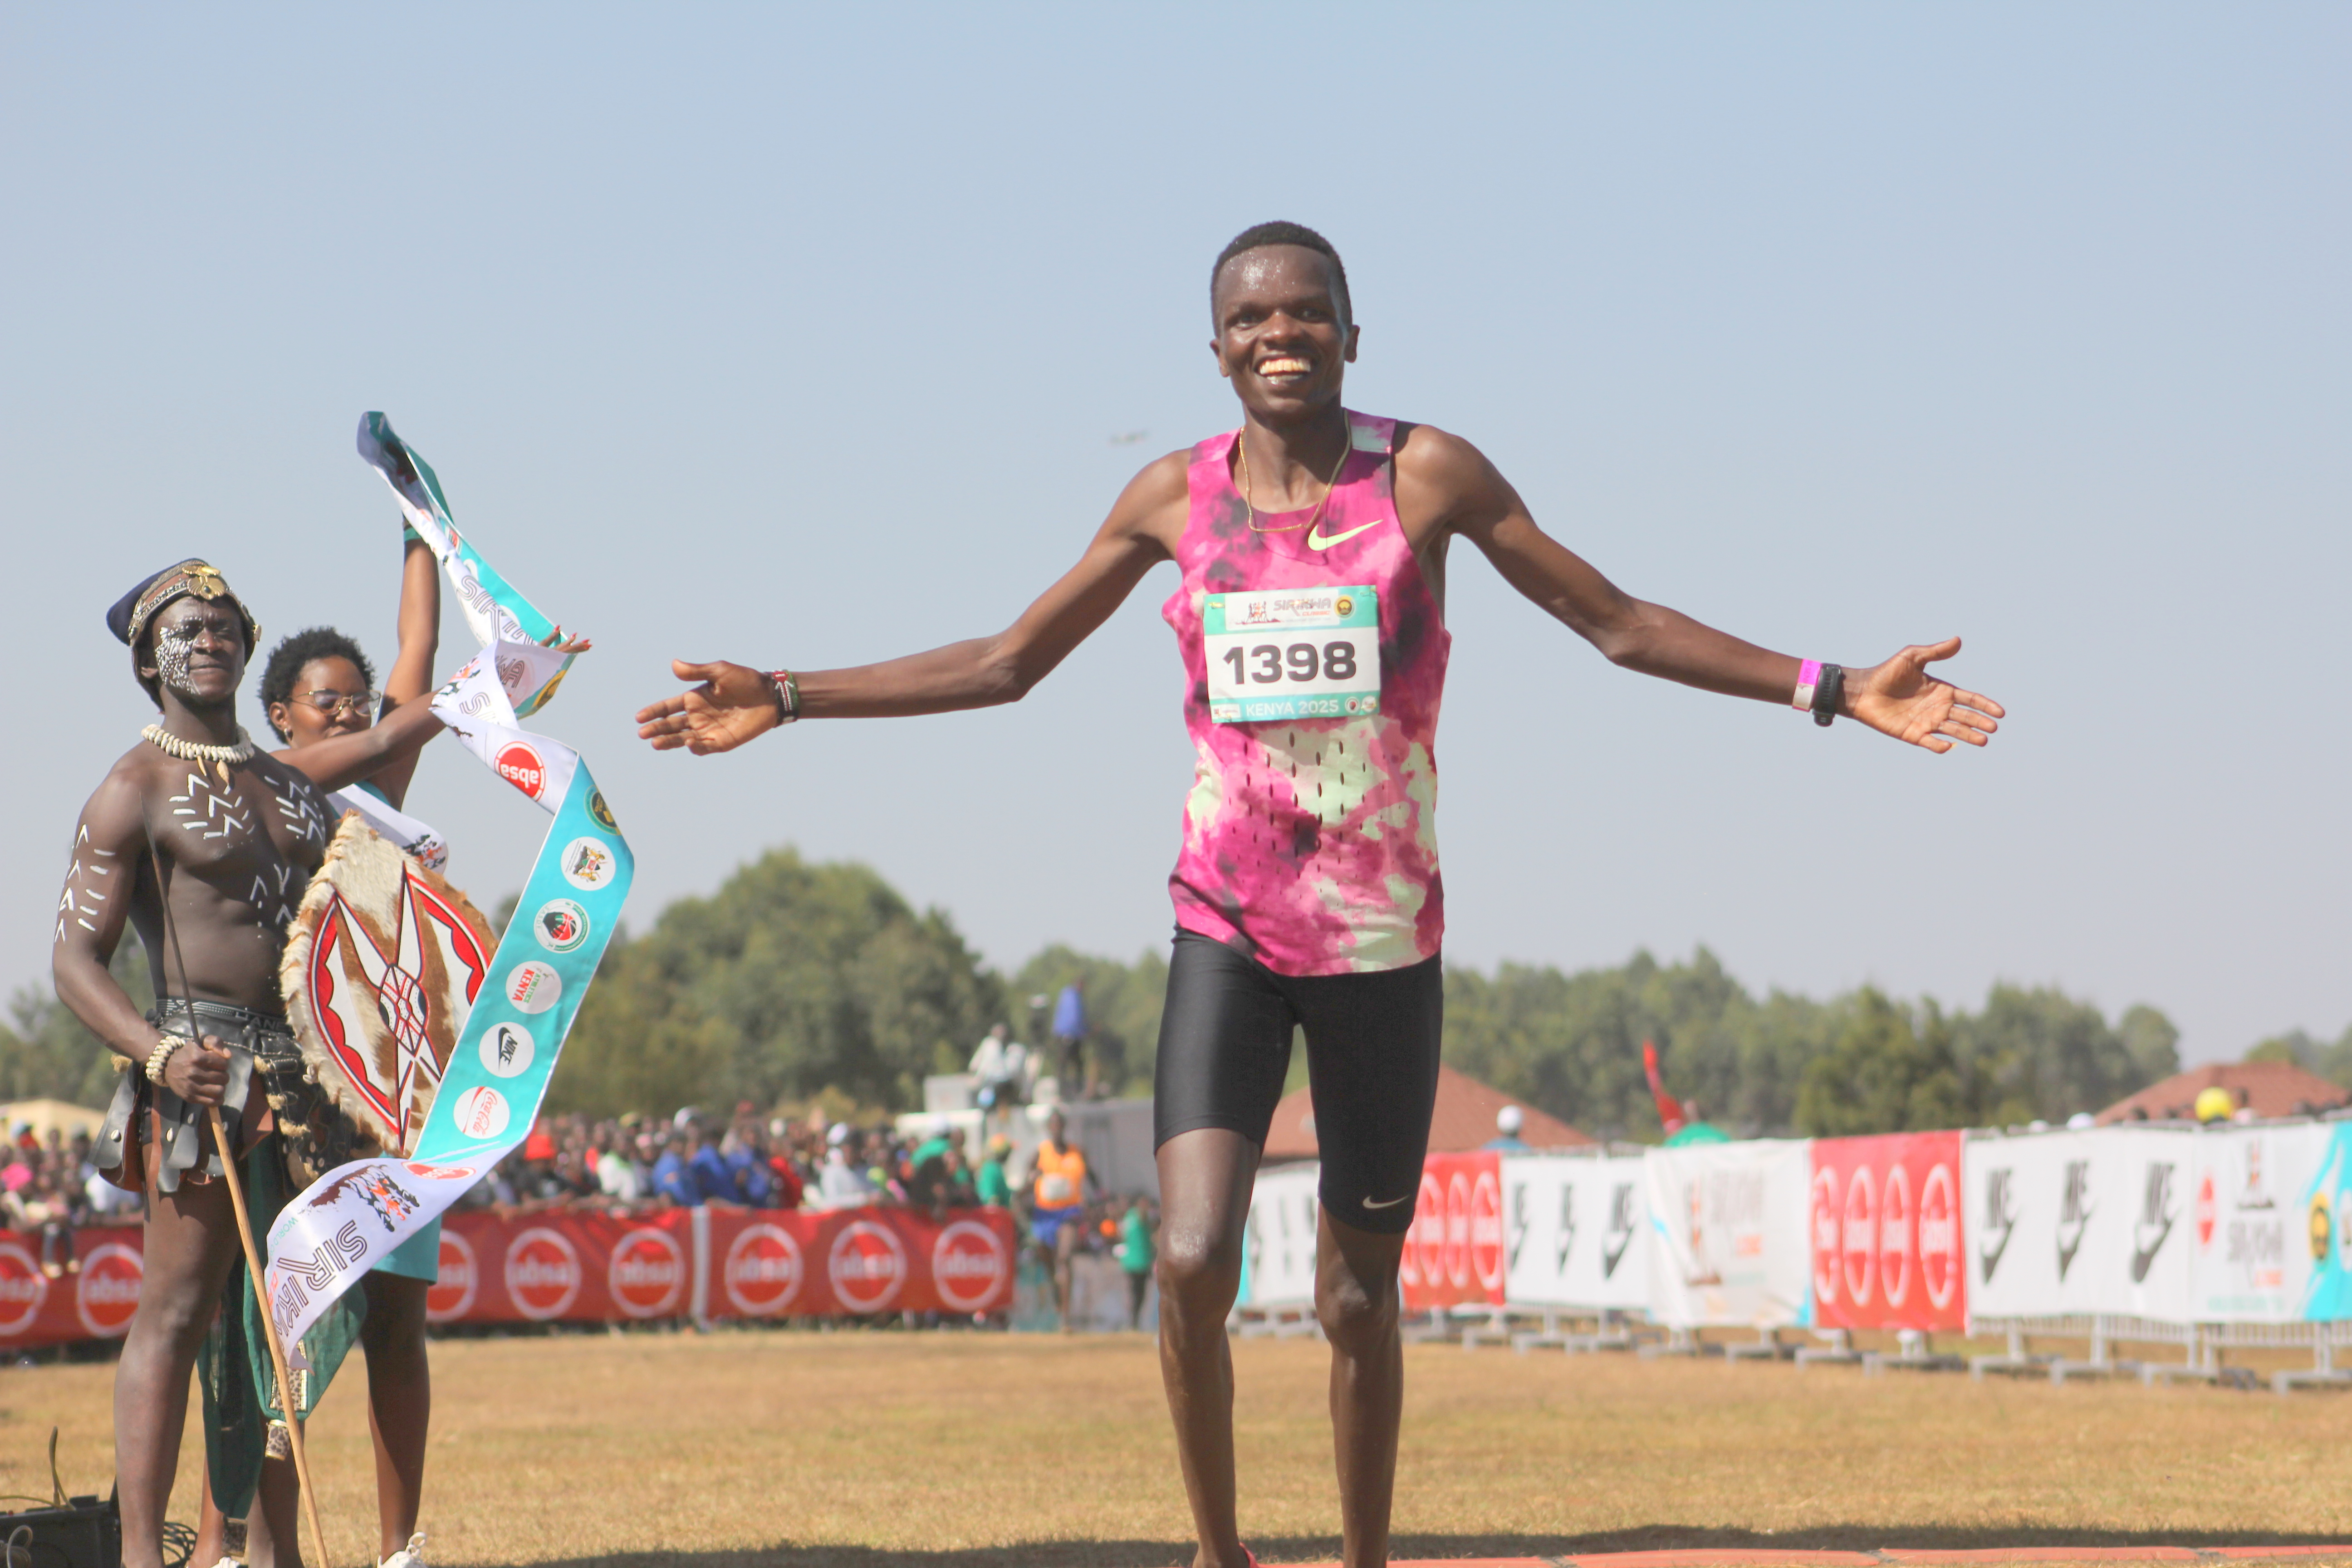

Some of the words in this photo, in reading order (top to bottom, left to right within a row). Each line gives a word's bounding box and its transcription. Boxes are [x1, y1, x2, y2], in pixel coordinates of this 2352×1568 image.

[1223, 641, 1356, 685] 1398
[1246, 703, 1294, 716] KENYA
[1298, 700, 1339, 714] 2025
[500, 763, 539, 789] absa
[512, 968, 535, 1001] KENYA
[523, 973, 541, 1003] ATHLETICS
[500, 1035, 518, 1067] NIKE
[274, 1216, 299, 1245] WORLD
